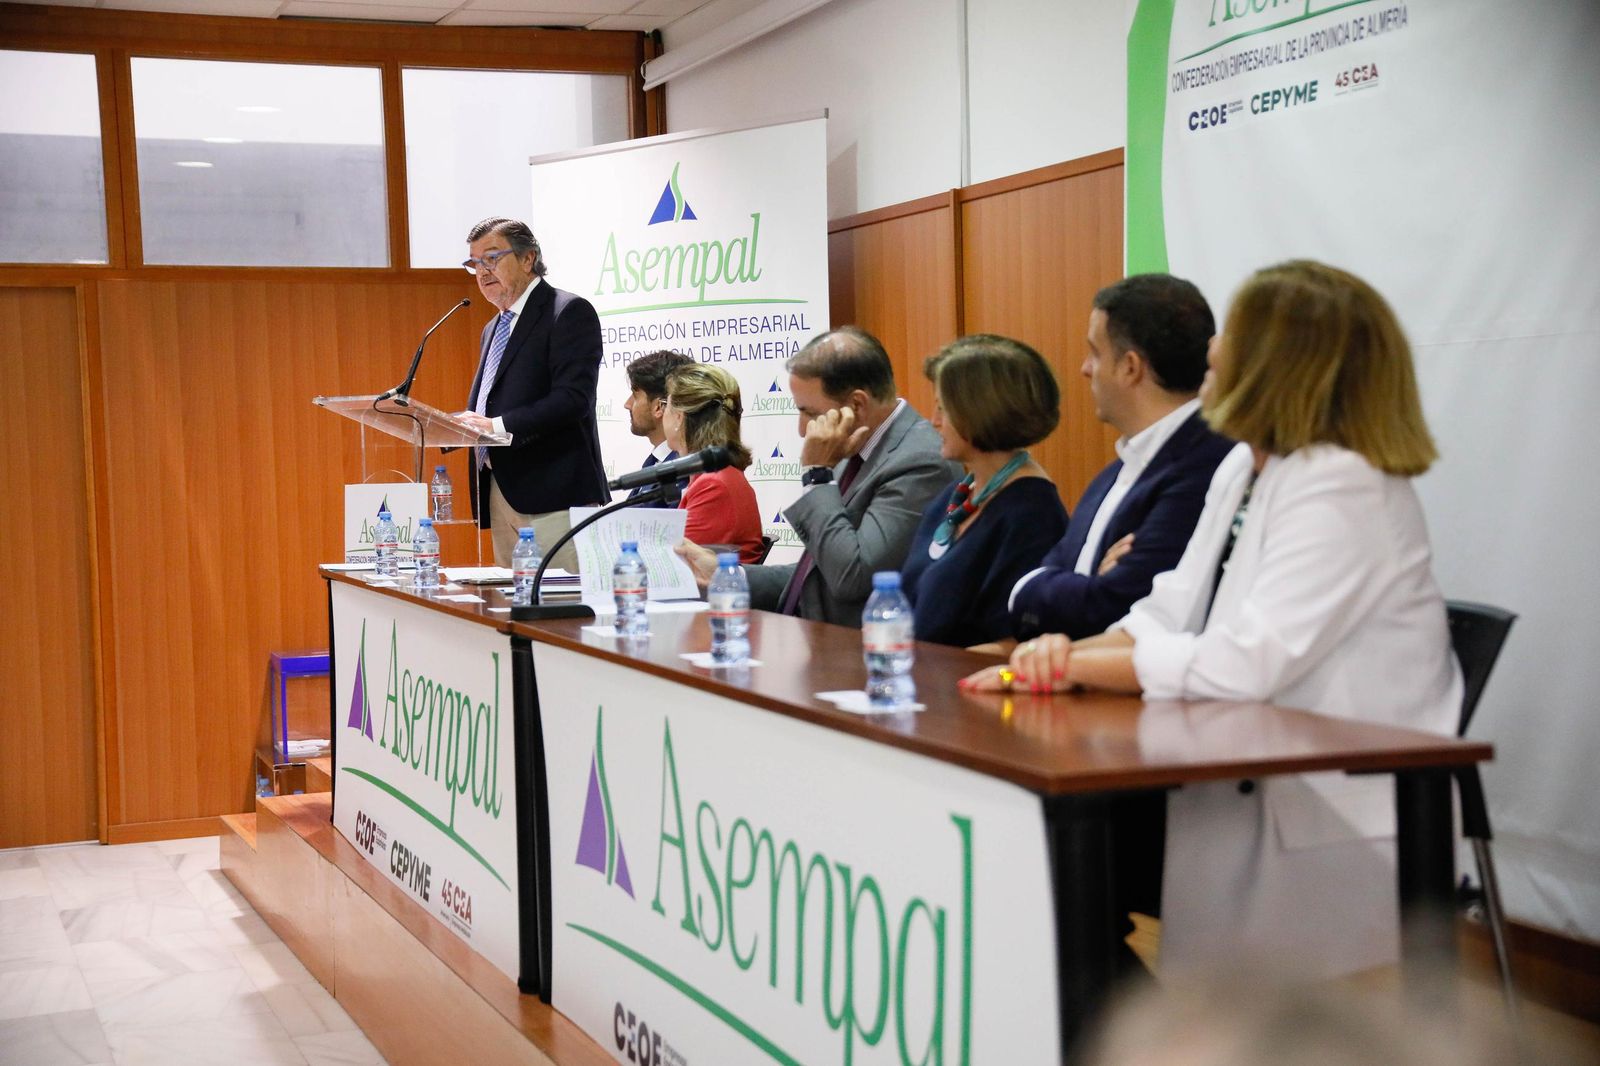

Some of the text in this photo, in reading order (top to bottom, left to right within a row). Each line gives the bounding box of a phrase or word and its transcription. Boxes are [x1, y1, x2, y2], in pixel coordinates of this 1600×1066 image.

[1229, 43, 1282, 77] EMPRESARIAL
[1285, 39, 1297, 62] DE
[1298, 35, 1308, 59] LA
[1309, 21, 1350, 56] PROVINCIA
[1353, 17, 1365, 42] DE
[1188, 103, 1228, 131] CEOE
[1250, 80, 1318, 115] CEPYME
[1335, 71, 1349, 88] 45
[1352, 63, 1379, 84] CEA
[594, 212, 762, 301] Asempal
[601, 313, 810, 344] EDERACIÓN EMPRESARIAL
[701, 345, 722, 363] DE
[728, 337, 800, 361] ALMERÍA
[380, 618, 502, 831] Asempal
[355, 810, 377, 855] CEOE
[390, 840, 431, 902] CEPYME
[441, 878, 452, 908] 45
[453, 886, 472, 924] CEA
[652, 715, 973, 1066] Asempal
[614, 1002, 662, 1066] CEOE
